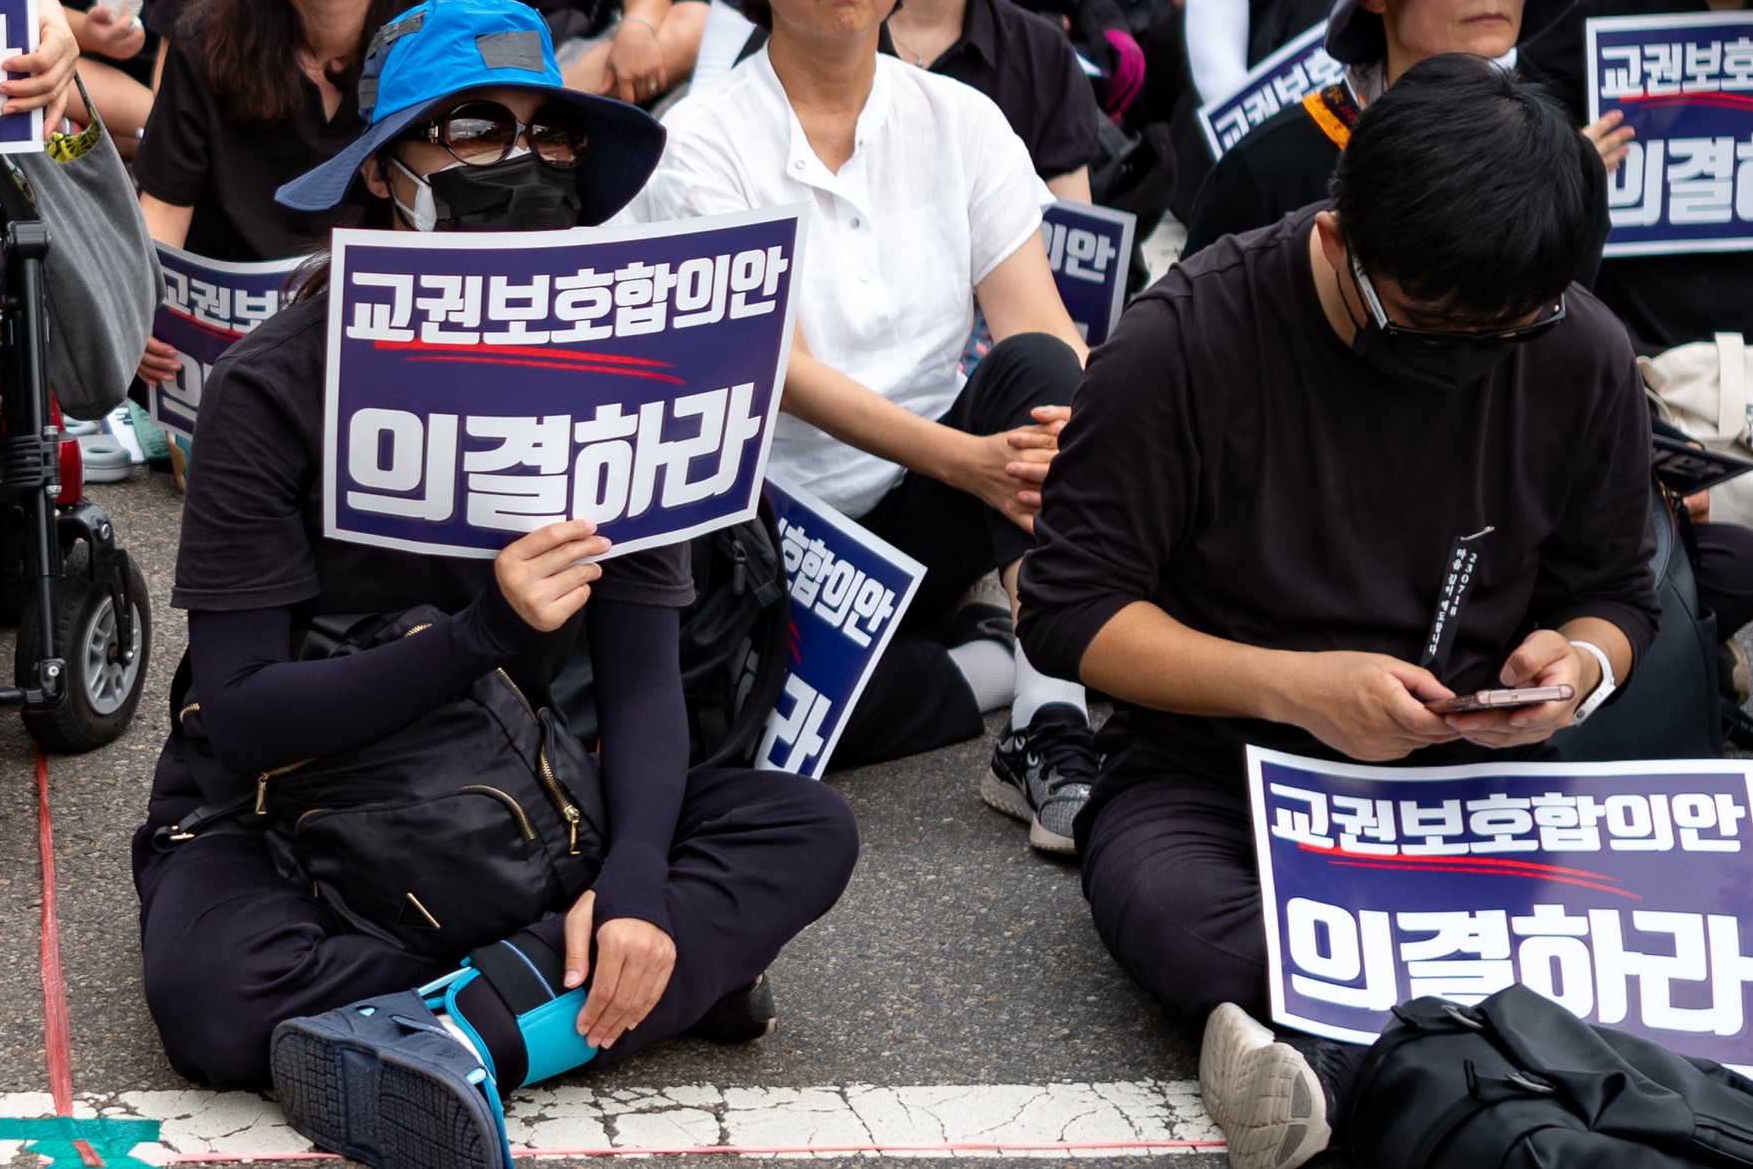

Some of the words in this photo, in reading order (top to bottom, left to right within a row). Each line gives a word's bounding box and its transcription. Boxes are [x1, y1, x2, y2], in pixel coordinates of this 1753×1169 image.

[346, 244, 789, 346] 교권보호합의안
[346, 382, 763, 530] 의결하라
[1450, 552, 1477, 617] 230718
[1270, 781, 1745, 855] 교권보호합의안
[1285, 895, 1753, 1036] 의결하라
